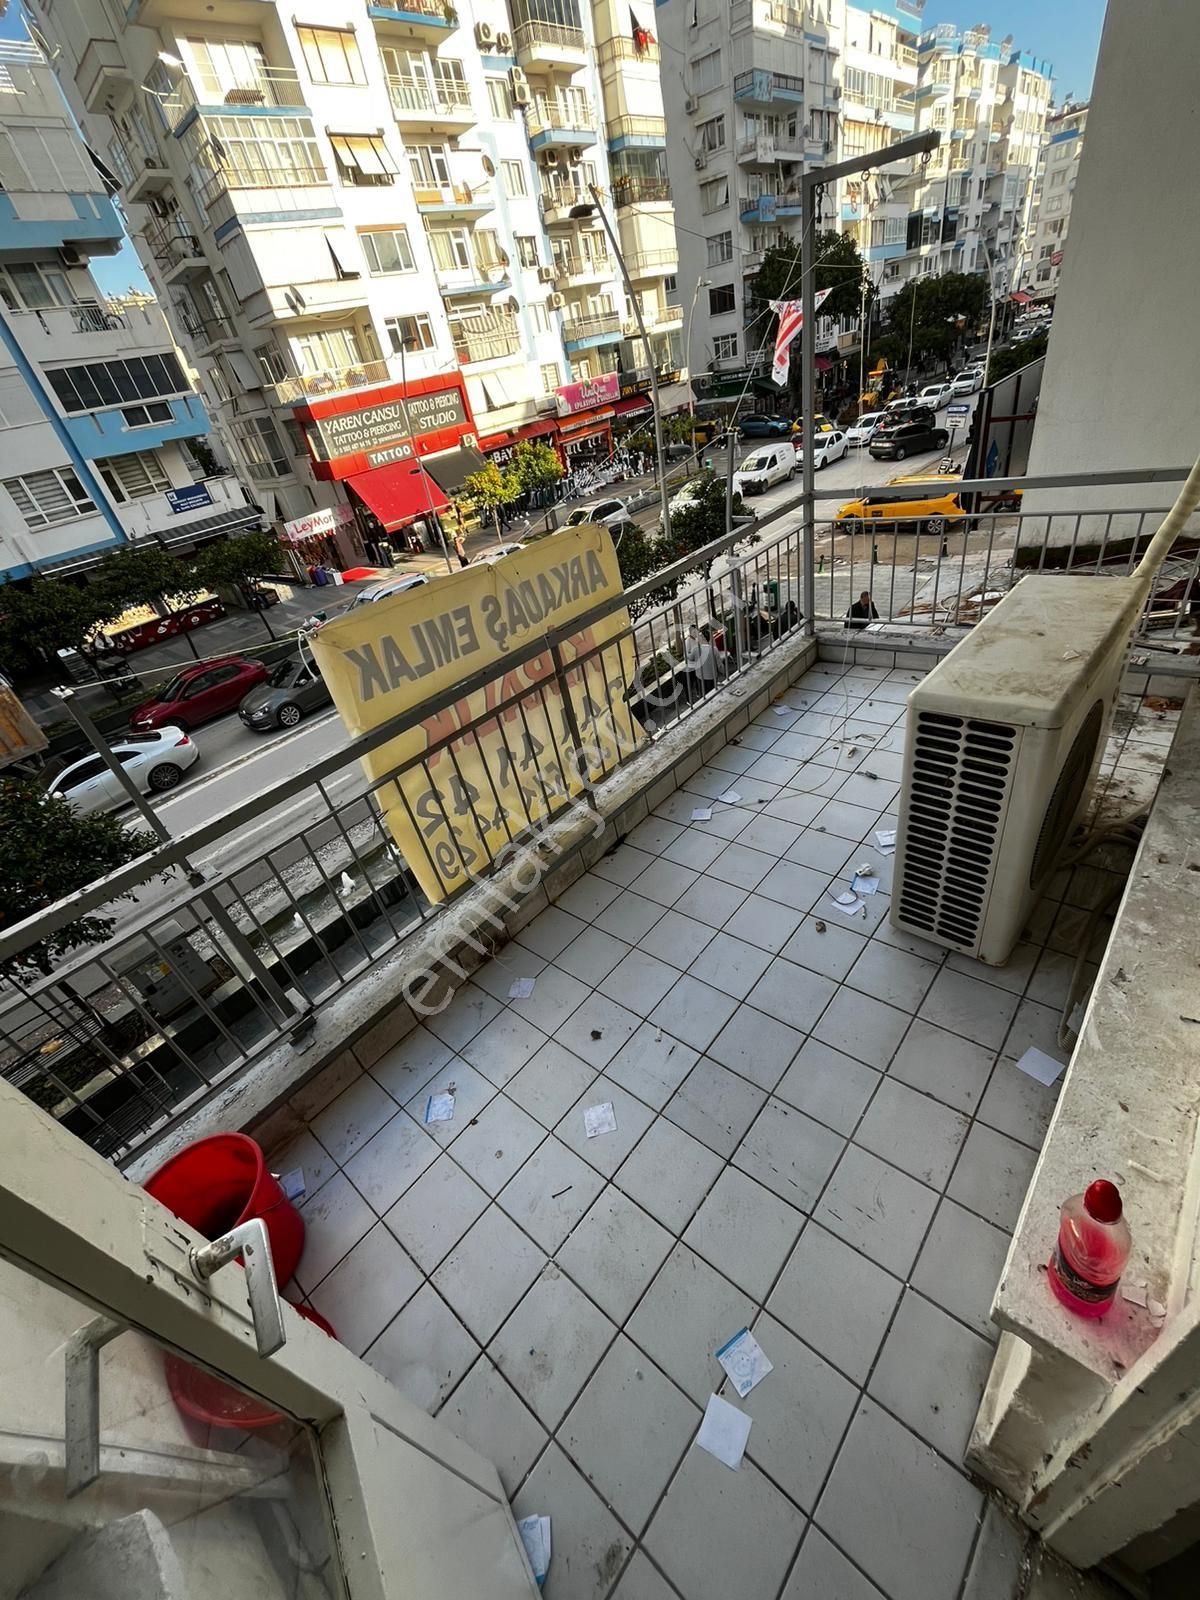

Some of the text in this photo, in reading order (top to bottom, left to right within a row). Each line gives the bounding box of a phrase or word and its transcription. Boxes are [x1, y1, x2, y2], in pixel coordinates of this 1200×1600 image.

[324, 404, 400, 434] YAREN CANSU
[420, 410, 456, 429] STUDIO
[333, 420, 401, 446] TATTOO & PIERCING
[369, 445, 411, 464] TATTOO
